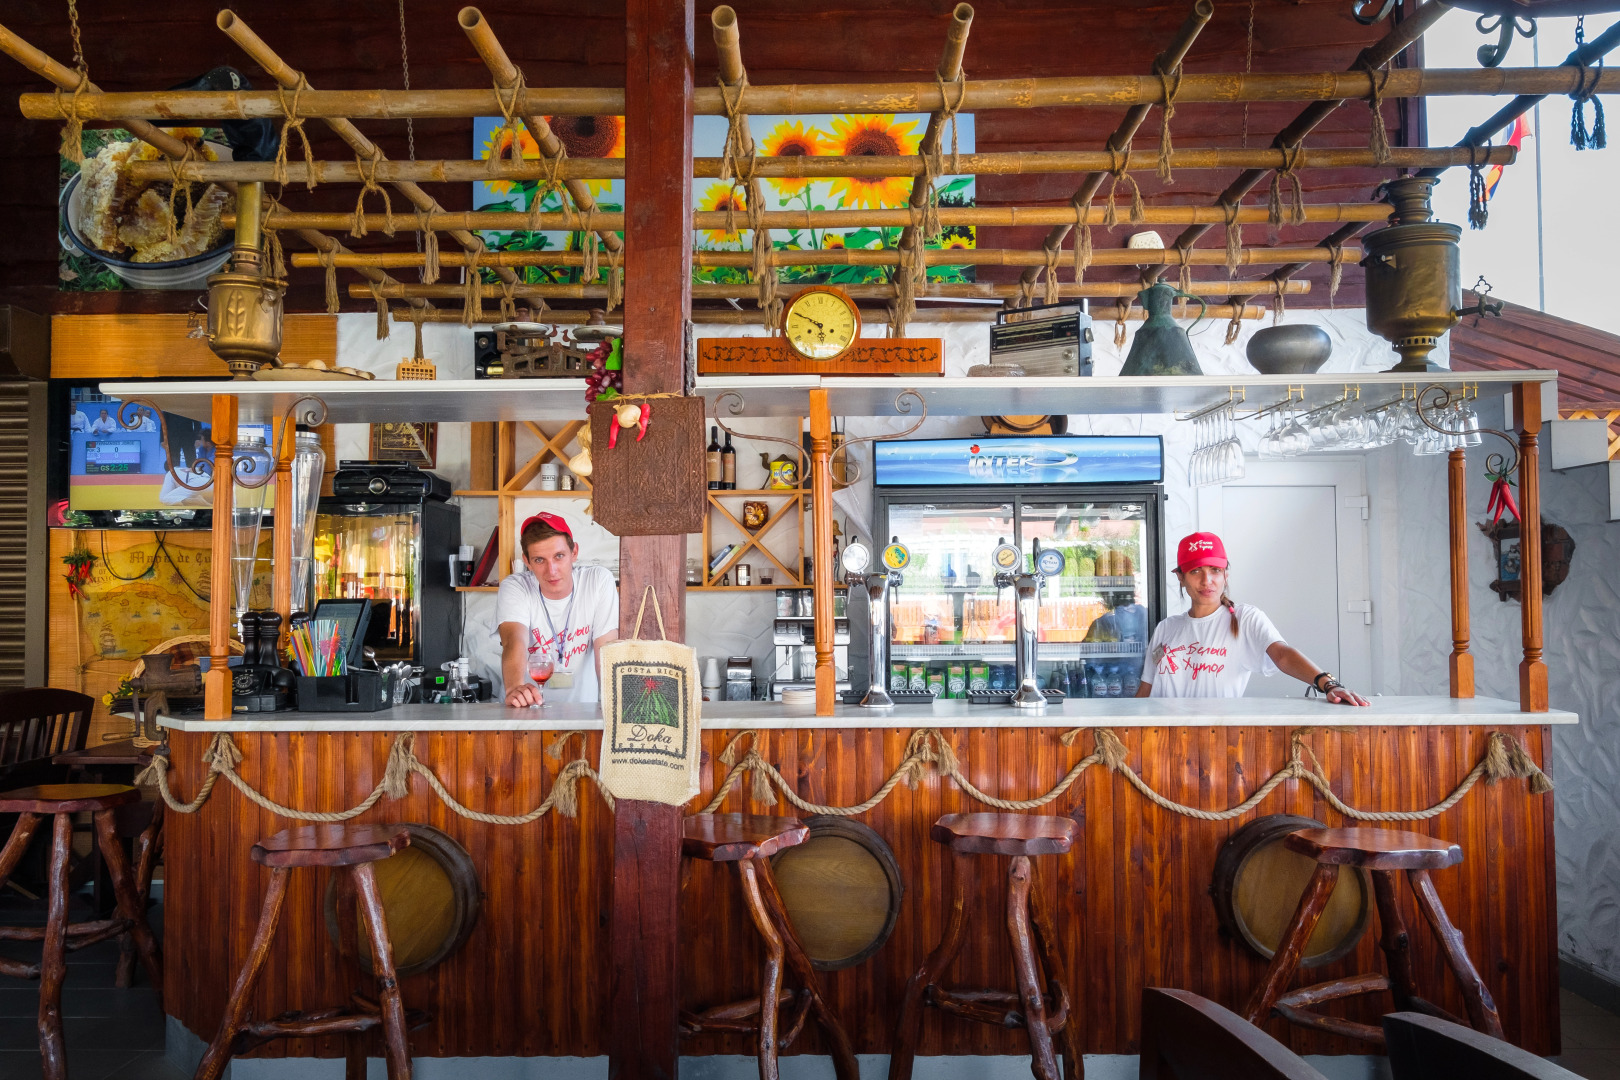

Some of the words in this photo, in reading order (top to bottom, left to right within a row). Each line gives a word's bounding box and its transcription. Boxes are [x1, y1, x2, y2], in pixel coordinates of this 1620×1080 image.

[110, 463, 129, 472] 2:25
[177, 551, 190, 563] de
[1186, 642, 1227, 657] Белый
[620, 666, 652, 674] COSTA
[657, 667, 680, 678] RICA
[1183, 657, 1225, 680] Хутор
[627, 724, 673, 745] Doka
[617, 742, 681, 754] ESTATE
[612, 757, 685, 771] www.dokaestate.com
